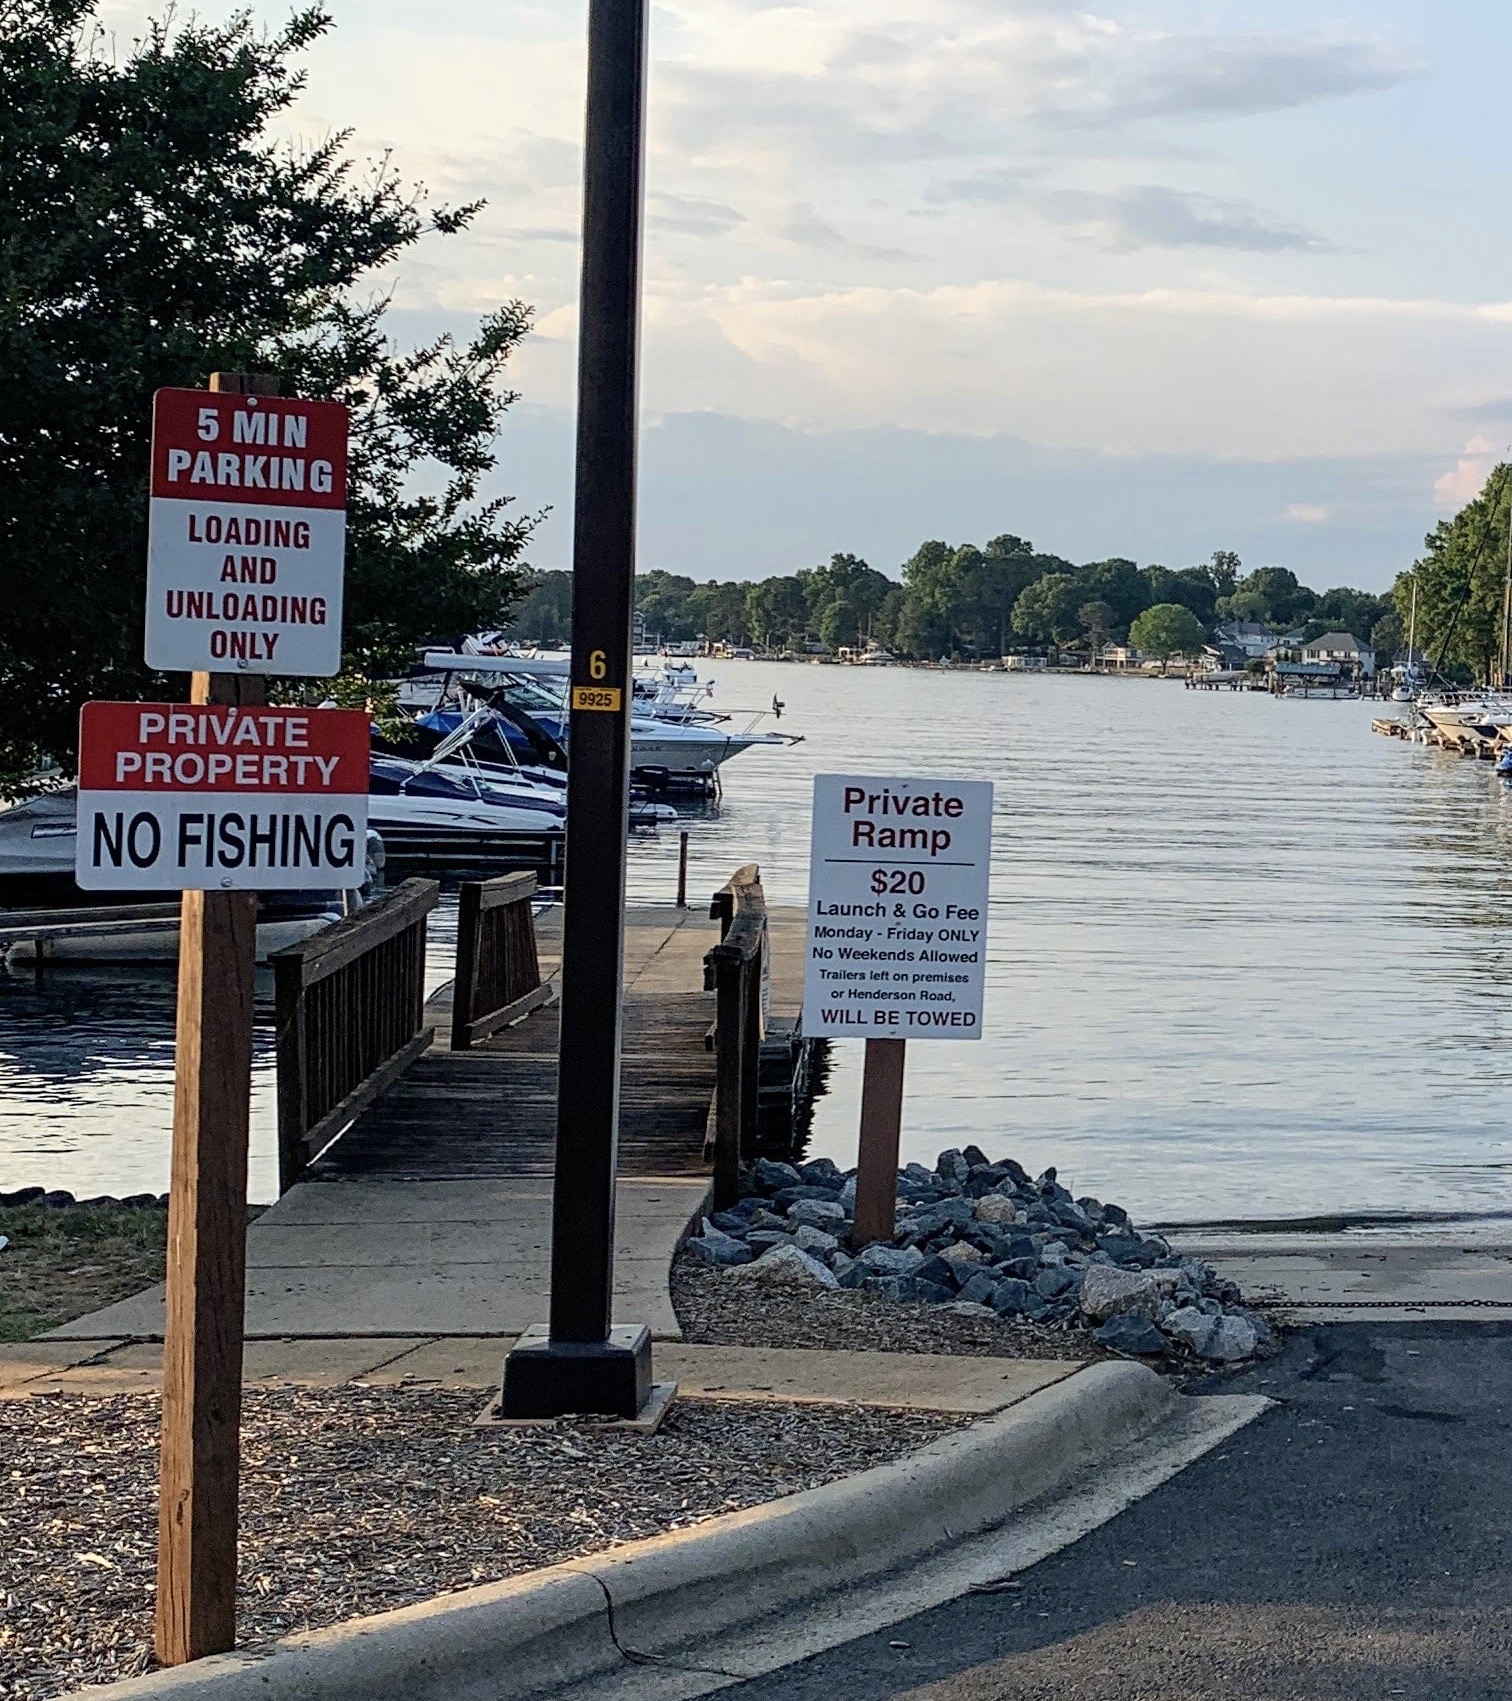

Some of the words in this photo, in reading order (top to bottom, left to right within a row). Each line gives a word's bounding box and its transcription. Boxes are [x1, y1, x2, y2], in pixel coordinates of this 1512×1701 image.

[197, 408, 219, 441] 5
[233, 410, 307, 448] MIN
[168, 449, 333, 493] PARKING
[188, 514, 311, 550] LOADING
[220, 555, 277, 584] AND
[166, 590, 326, 625] UNLOADING
[210, 629, 279, 660] ONLY
[590, 650, 606, 680] 6
[579, 691, 613, 706] 9925
[139, 712, 309, 748] PRIVATE
[116, 751, 340, 786] PROPERTY
[844, 787, 964, 818] Private
[93, 811, 161, 868] NO
[177, 812, 355, 869] FISHING
[852, 820, 951, 857] Ramp
[870, 868, 926, 897] $20
[816, 900, 886, 917] Launch
[893, 903, 906, 918] &
[912, 903, 939, 919] Go
[945, 904, 980, 921] Fee
[814, 925, 874, 942] Monday
[887, 927, 934, 943] Friday
[938, 929, 980, 942] ONLY
[812, 947, 833, 960] No
[838, 947, 915, 962] Weekends
[918, 949, 978, 963] Allowed
[819, 968, 866, 981] Trailers
[870, 970, 889, 981] left
[893, 972, 908, 982] on
[912, 972, 969, 984] premises
[831, 989, 844, 999] or
[848, 988, 916, 1001] Henderson
[821, 1009, 868, 1024] WILL
[874, 1010, 900, 1025] BE
[906, 1011, 976, 1027] TOWED
